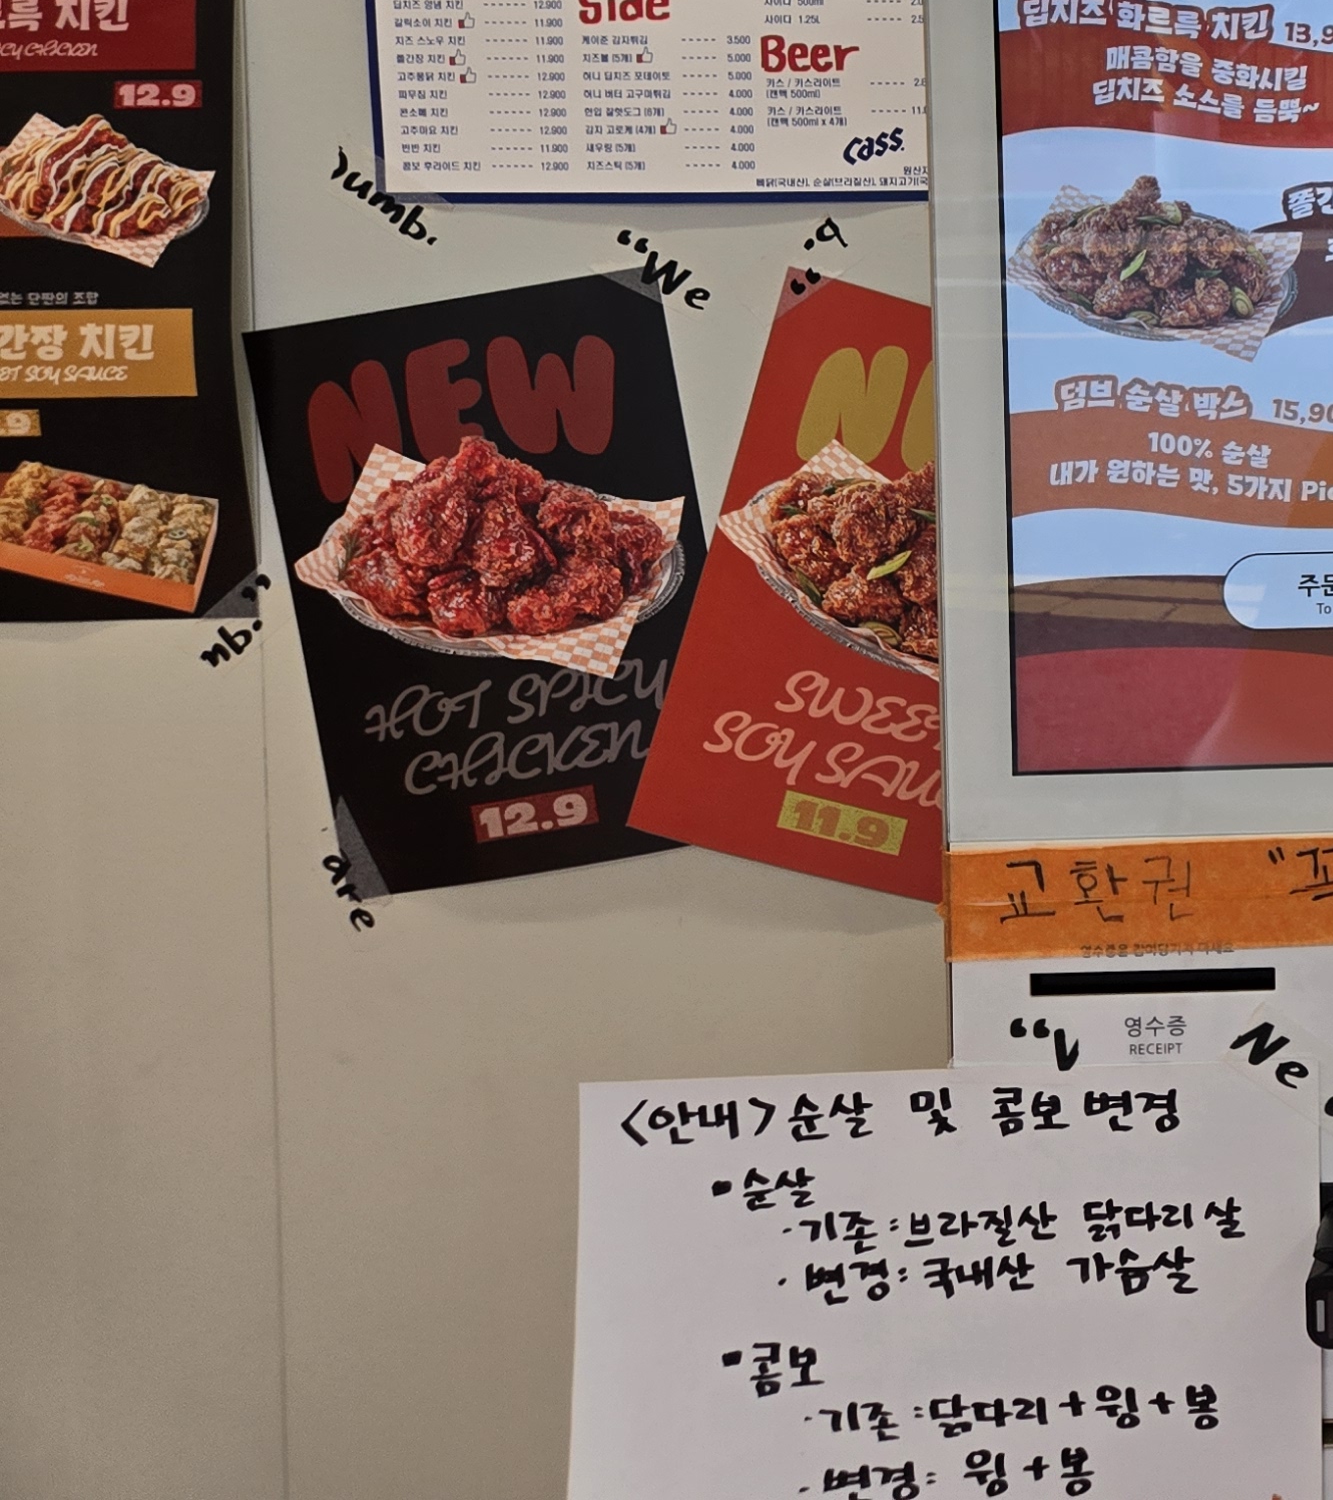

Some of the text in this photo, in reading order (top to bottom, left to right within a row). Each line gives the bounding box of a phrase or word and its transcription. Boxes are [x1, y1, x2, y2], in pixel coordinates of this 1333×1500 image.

[1117, 2, 1201, 39] 화르륵
[1211, 10, 1270, 41] 치킨
[760, 35, 860, 72] Beer
[1106, 46, 1308, 91] 매콤함을 중화시킬
[117, 83, 196, 108] 12.9
[1092, 77, 1165, 105] 딥치즈
[1173, 84, 1245, 118] 소스를
[80, 323, 154, 361] 치킨
[307, 335, 615, 503] NEW
[1060, 381, 1115, 412] 덤브
[1125, 382, 1183, 418] 순살
[1193, 391, 1248, 421] 박스
[1148, 432, 1271, 469] 100% 순살
[1050, 460, 1099, 485] 내가
[1107, 459, 1180, 488] 원하는
[1188, 467, 1218, 495] 맛,
[1227, 473, 1293, 503] 5가지
[1316, 603, 1331, 615] To
[703, 711, 817, 785] SOY
[479, 793, 590, 840] 12.9
[791, 798, 890, 847] 11.9
[1001, 853, 1193, 924] 교환권
[1124, 1016, 1187, 1038] 영수증
[1129, 1042, 1183, 1056] RECEIPT
[910, 1088, 957, 1135] 및
[1066, 1246, 1199, 1296] 가슴살
